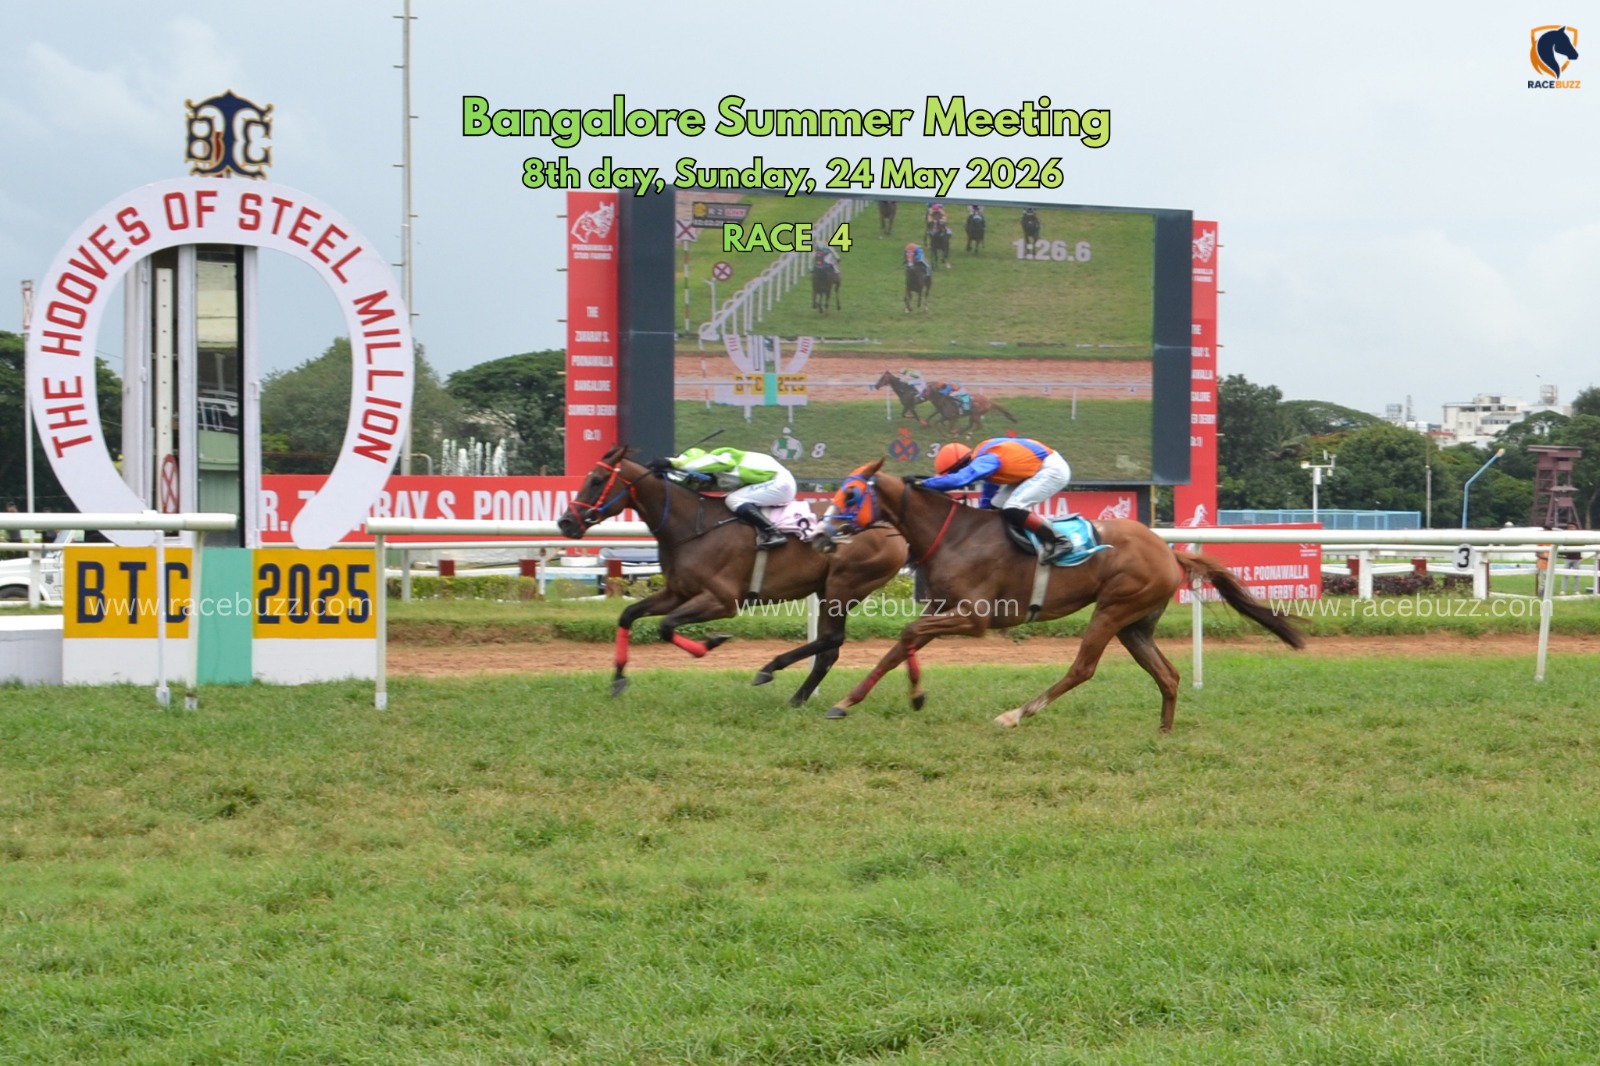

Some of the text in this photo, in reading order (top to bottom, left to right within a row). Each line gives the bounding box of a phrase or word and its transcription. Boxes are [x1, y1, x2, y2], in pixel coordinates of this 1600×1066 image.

[1012, 238, 1092, 262] 1:26.6
[40, 190, 406, 465] THE HOOVES OF STEEL MILLION
[811, 442, 826, 458] 8
[926, 442, 941, 458] 3
[1457, 547, 1471, 569] 3
[258, 563, 370, 624] 2025
